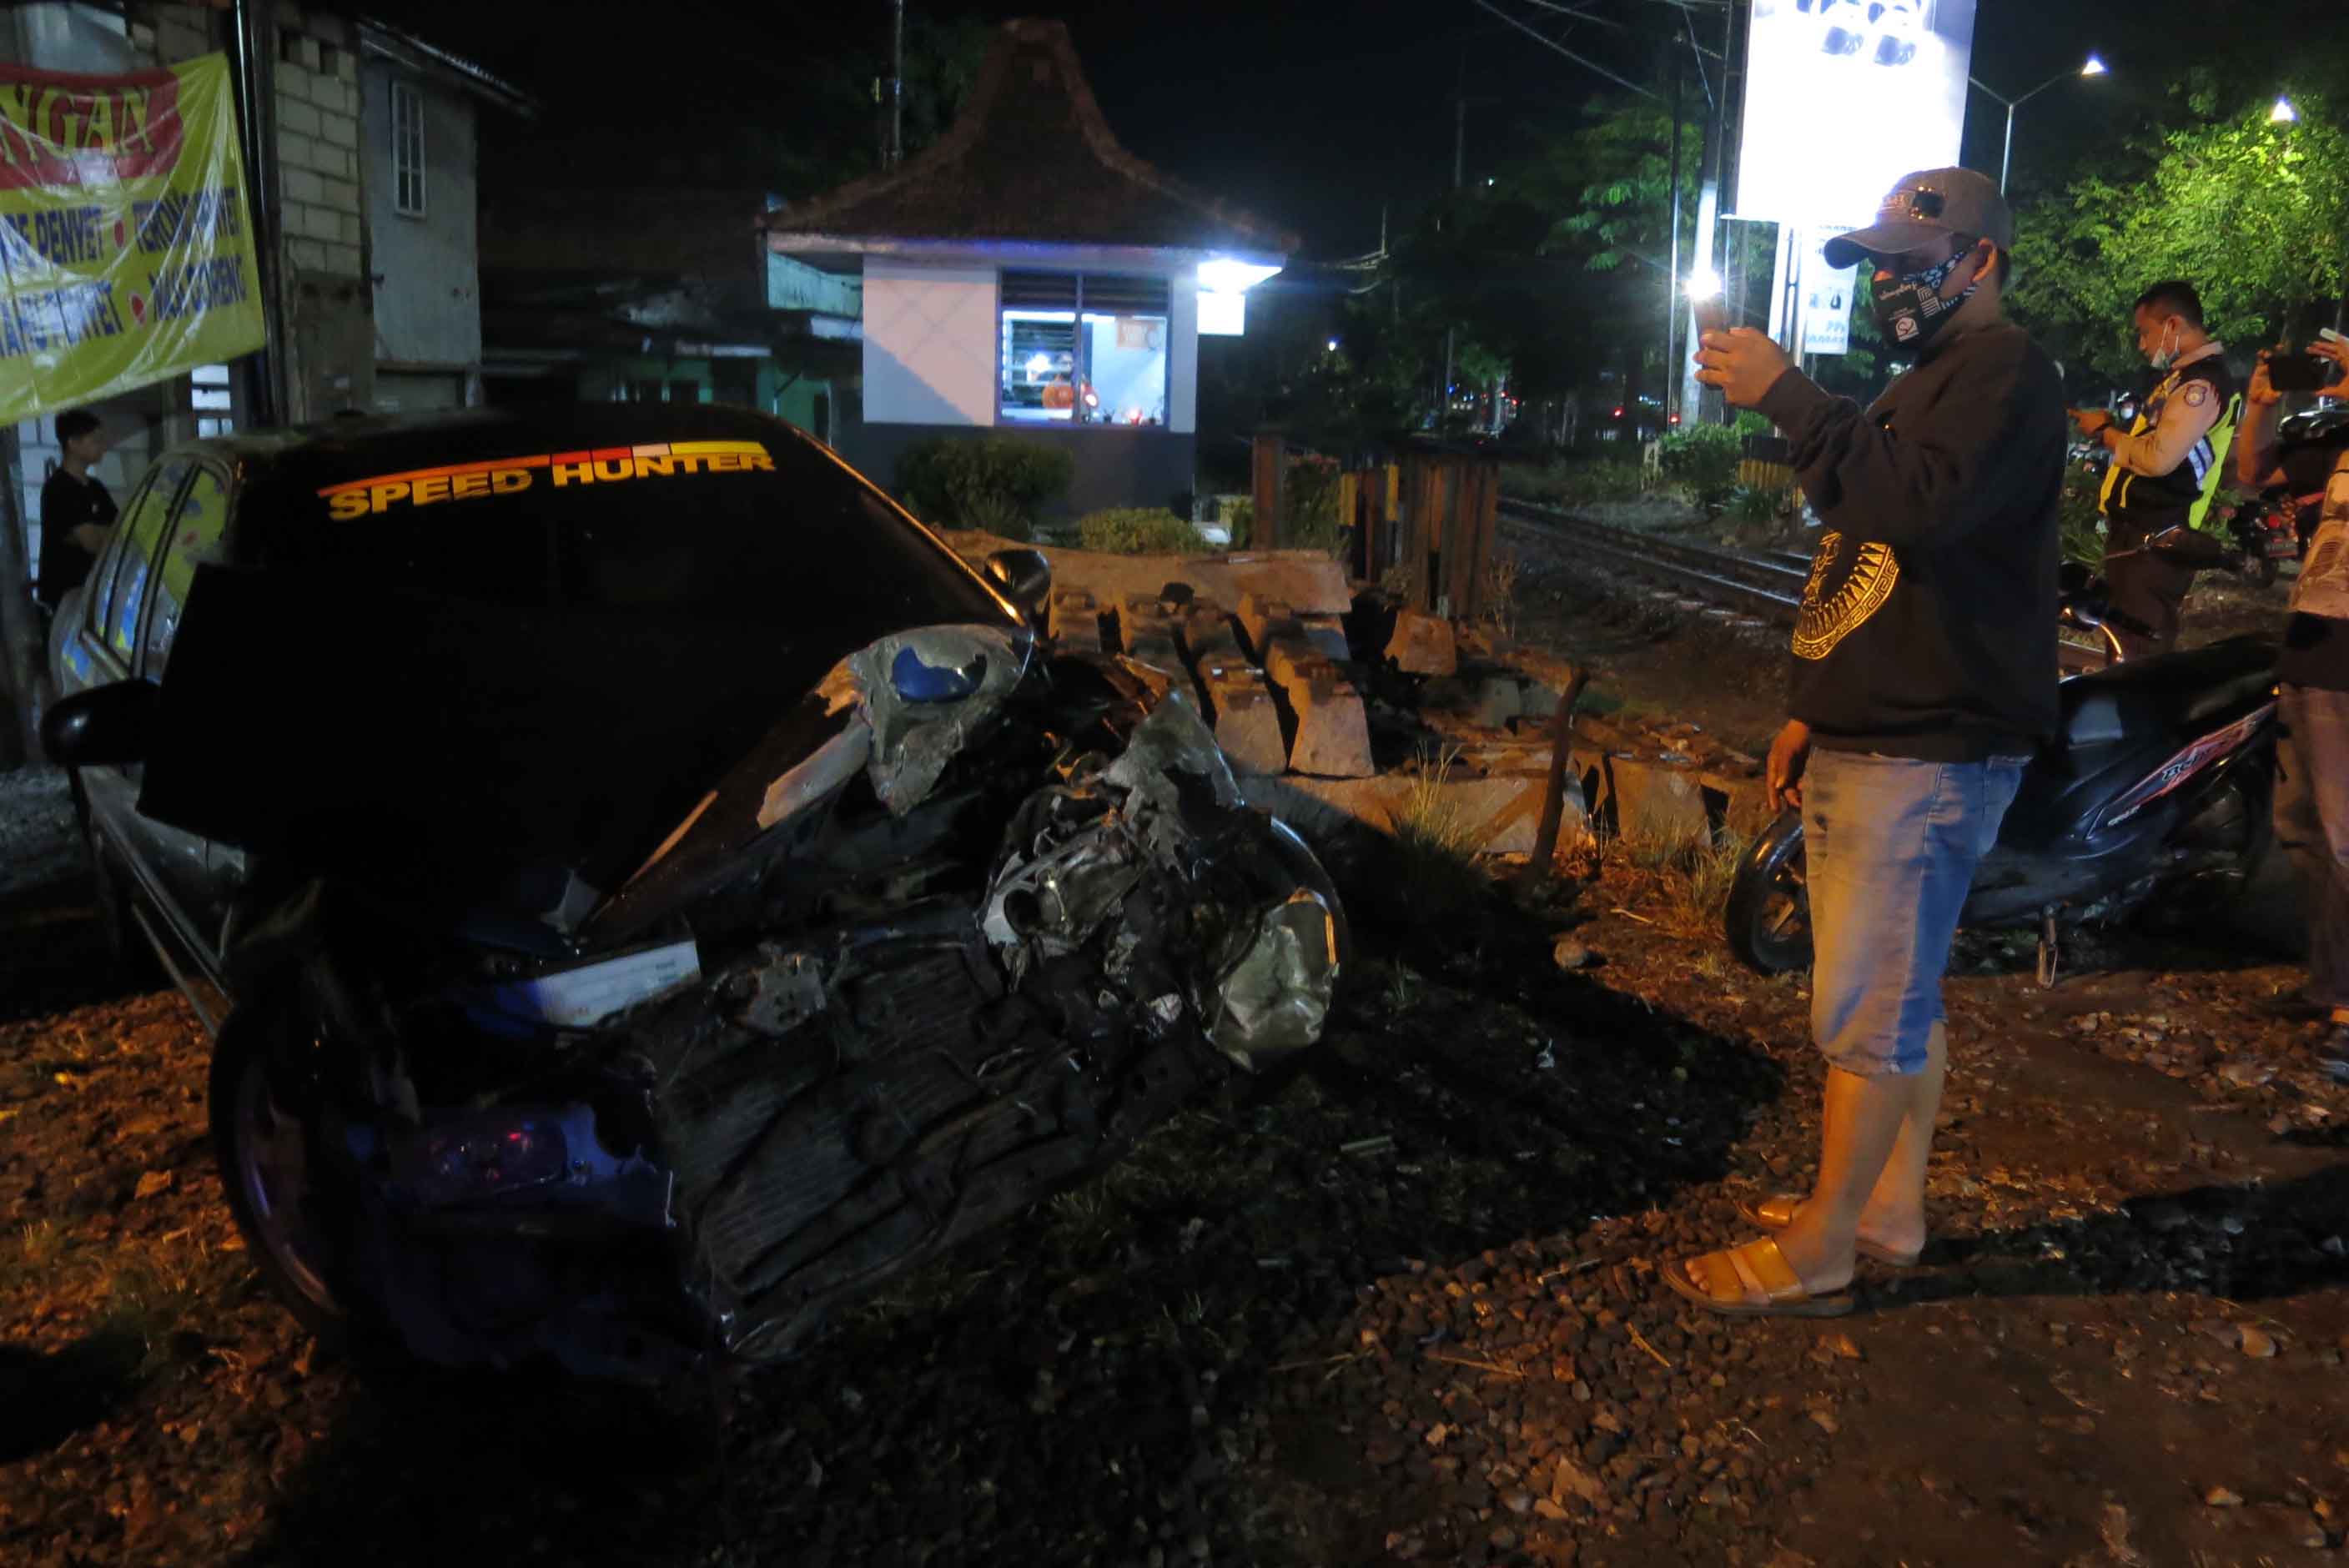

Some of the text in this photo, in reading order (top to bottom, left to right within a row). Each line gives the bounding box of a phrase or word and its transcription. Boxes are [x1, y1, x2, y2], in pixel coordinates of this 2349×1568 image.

[35, 206, 103, 264] PENYET
[329, 454, 775, 520] SPEED HUNTER
